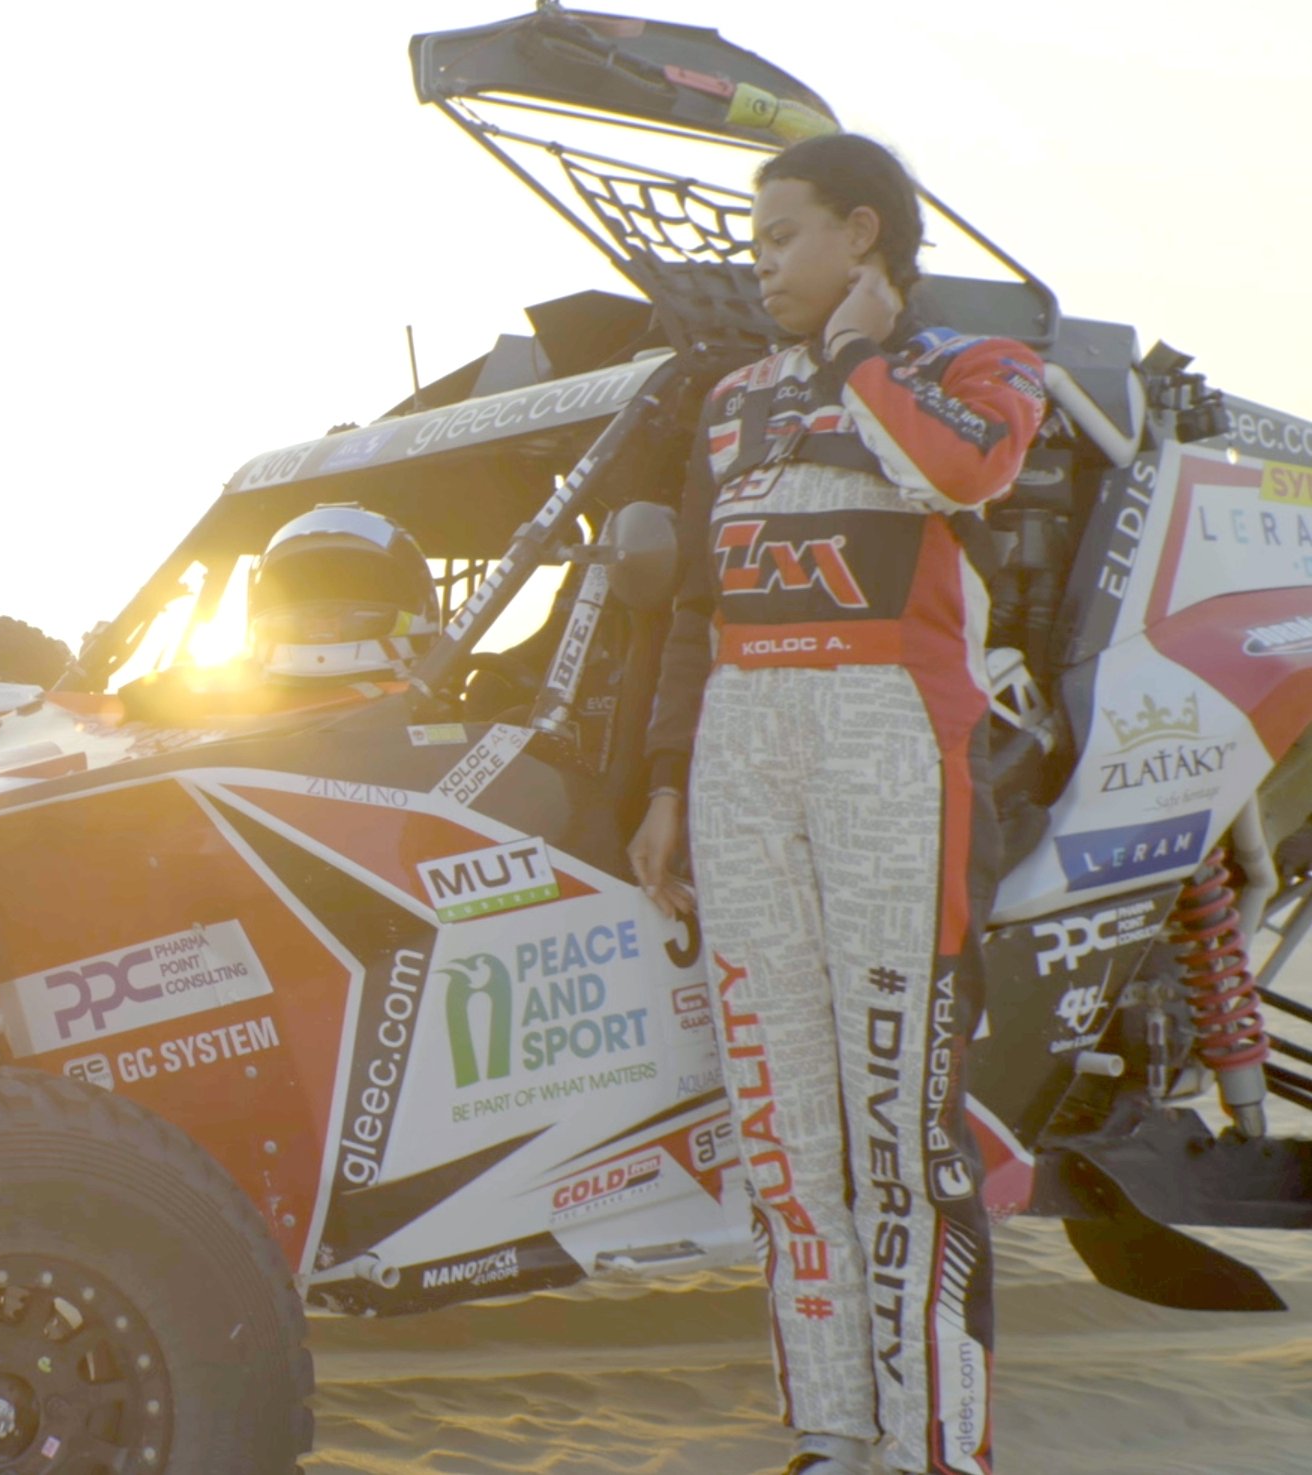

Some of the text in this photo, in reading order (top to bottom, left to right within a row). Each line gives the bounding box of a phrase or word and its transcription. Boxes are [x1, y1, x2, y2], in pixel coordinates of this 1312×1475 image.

[407, 371, 635, 457] gleec.com
[1199, 506, 1312, 547] LERA
[743, 637, 851, 655] KOLOC A.
[306, 777, 408, 808] ZINZINO
[439, 744, 490, 798] KOLOC
[454, 755, 504, 805] DUPLE
[428, 848, 539, 899] MUT
[1083, 832, 1192, 873] LERAM
[154, 934, 209, 959] PHARMA
[160, 955, 201, 977] POINT
[516, 920, 640, 982] PEACE
[1032, 910, 1117, 977] PPC
[44, 948, 163, 1040] PPC
[166, 963, 248, 995] CONSULTING
[521, 973, 605, 1027] AND
[118, 1048, 158, 1083] GC
[160, 1016, 280, 1073] SYSTEM
[342, 948, 424, 1186] gleec.com
[522, 1009, 648, 1072] SPORT
[927, 971, 956, 1150] BUGGYRA
[452, 1062, 658, 1123] BE PART OF WHAT MATTERS
[553, 1169, 625, 1208] GOLD
[959, 1342, 974, 1455] gleec.com
